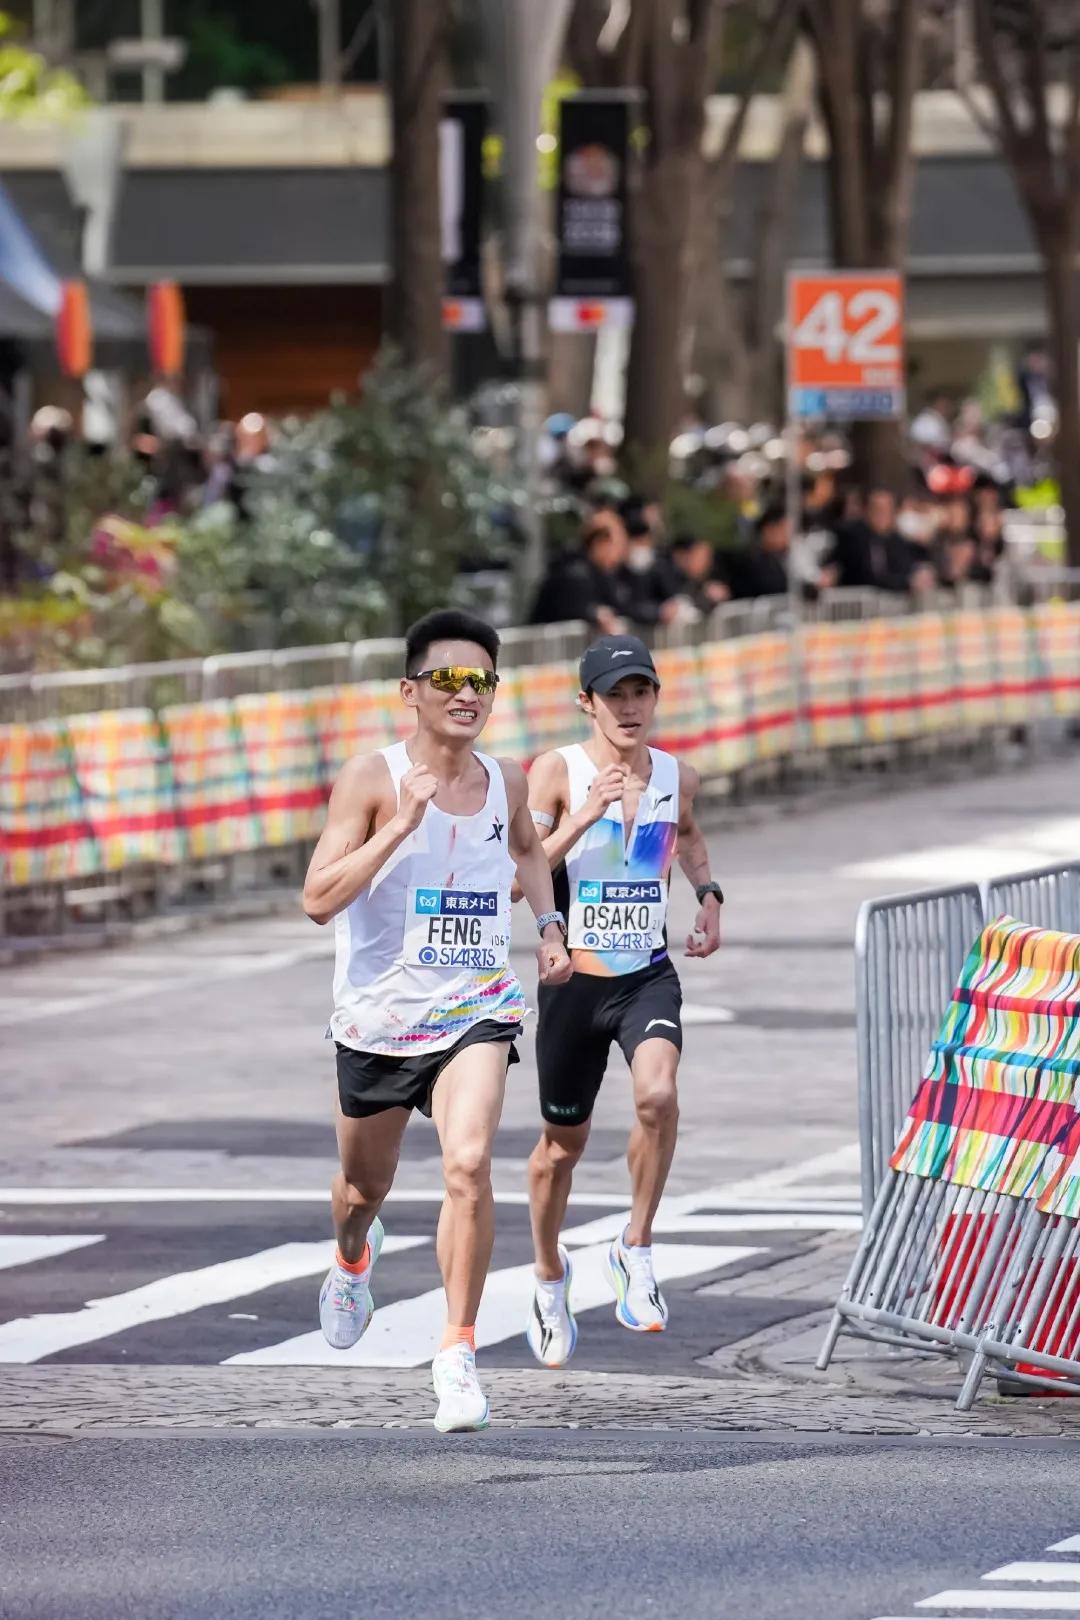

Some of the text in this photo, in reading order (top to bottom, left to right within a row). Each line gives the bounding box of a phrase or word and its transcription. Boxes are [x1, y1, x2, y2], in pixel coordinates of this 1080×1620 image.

[792, 290, 898, 363] 42
[445, 897, 495, 909] 東京メトロ
[606, 886, 659, 898] 東京メトロ
[583, 905, 650, 930] OSAKO
[428, 916, 482, 946] FENG
